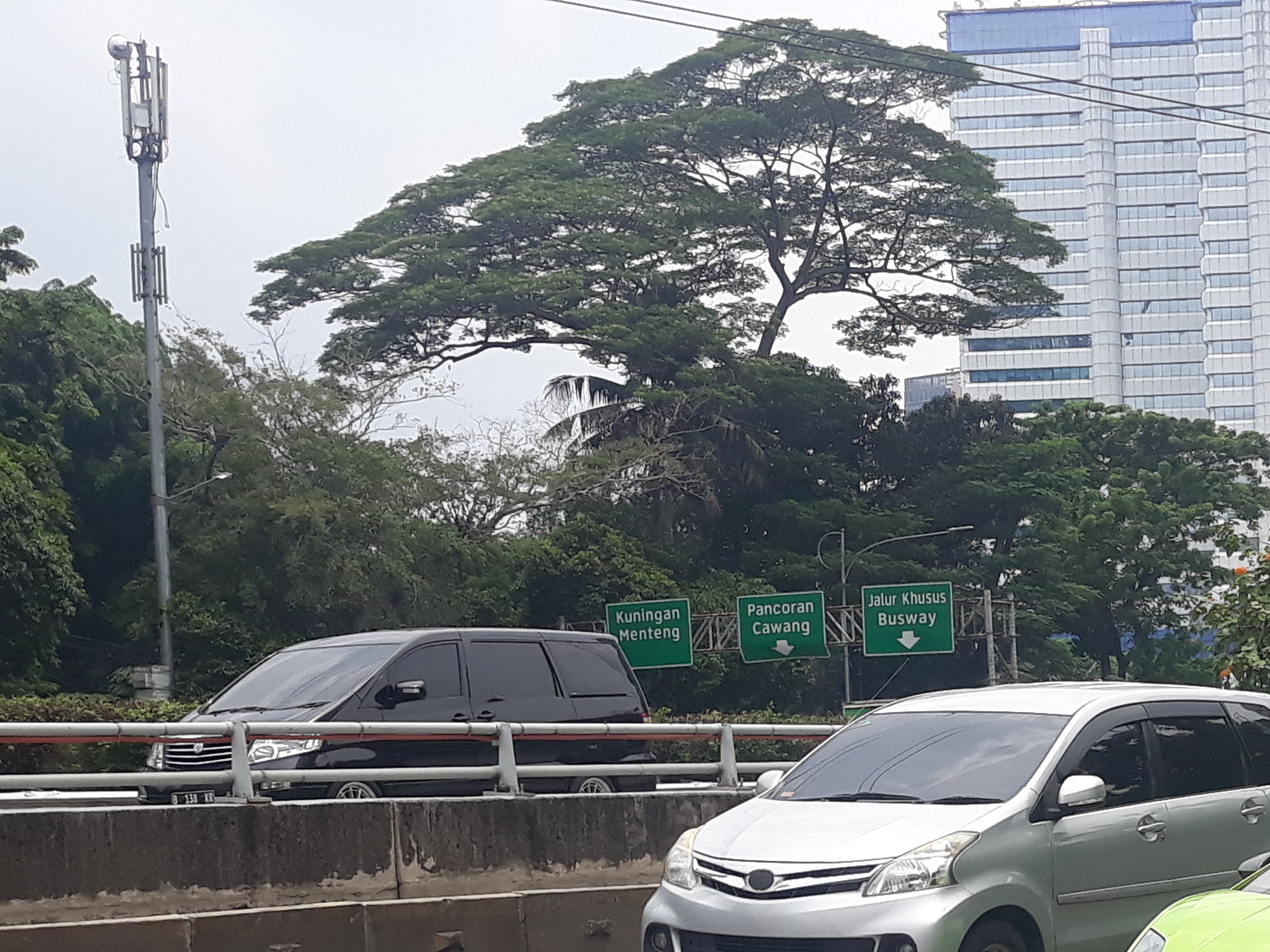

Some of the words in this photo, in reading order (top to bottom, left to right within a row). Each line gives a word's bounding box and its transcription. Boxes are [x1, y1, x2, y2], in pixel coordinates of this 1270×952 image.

[868, 592, 897, 607] Jalur
[902, 591, 947, 606] Khusus
[616, 608, 680, 625] Kuningan
[747, 601, 814, 617] Pancoran
[878, 612, 937, 627] Busway
[619, 627, 680, 642] Menteng
[752, 620, 810, 636] Cawang
